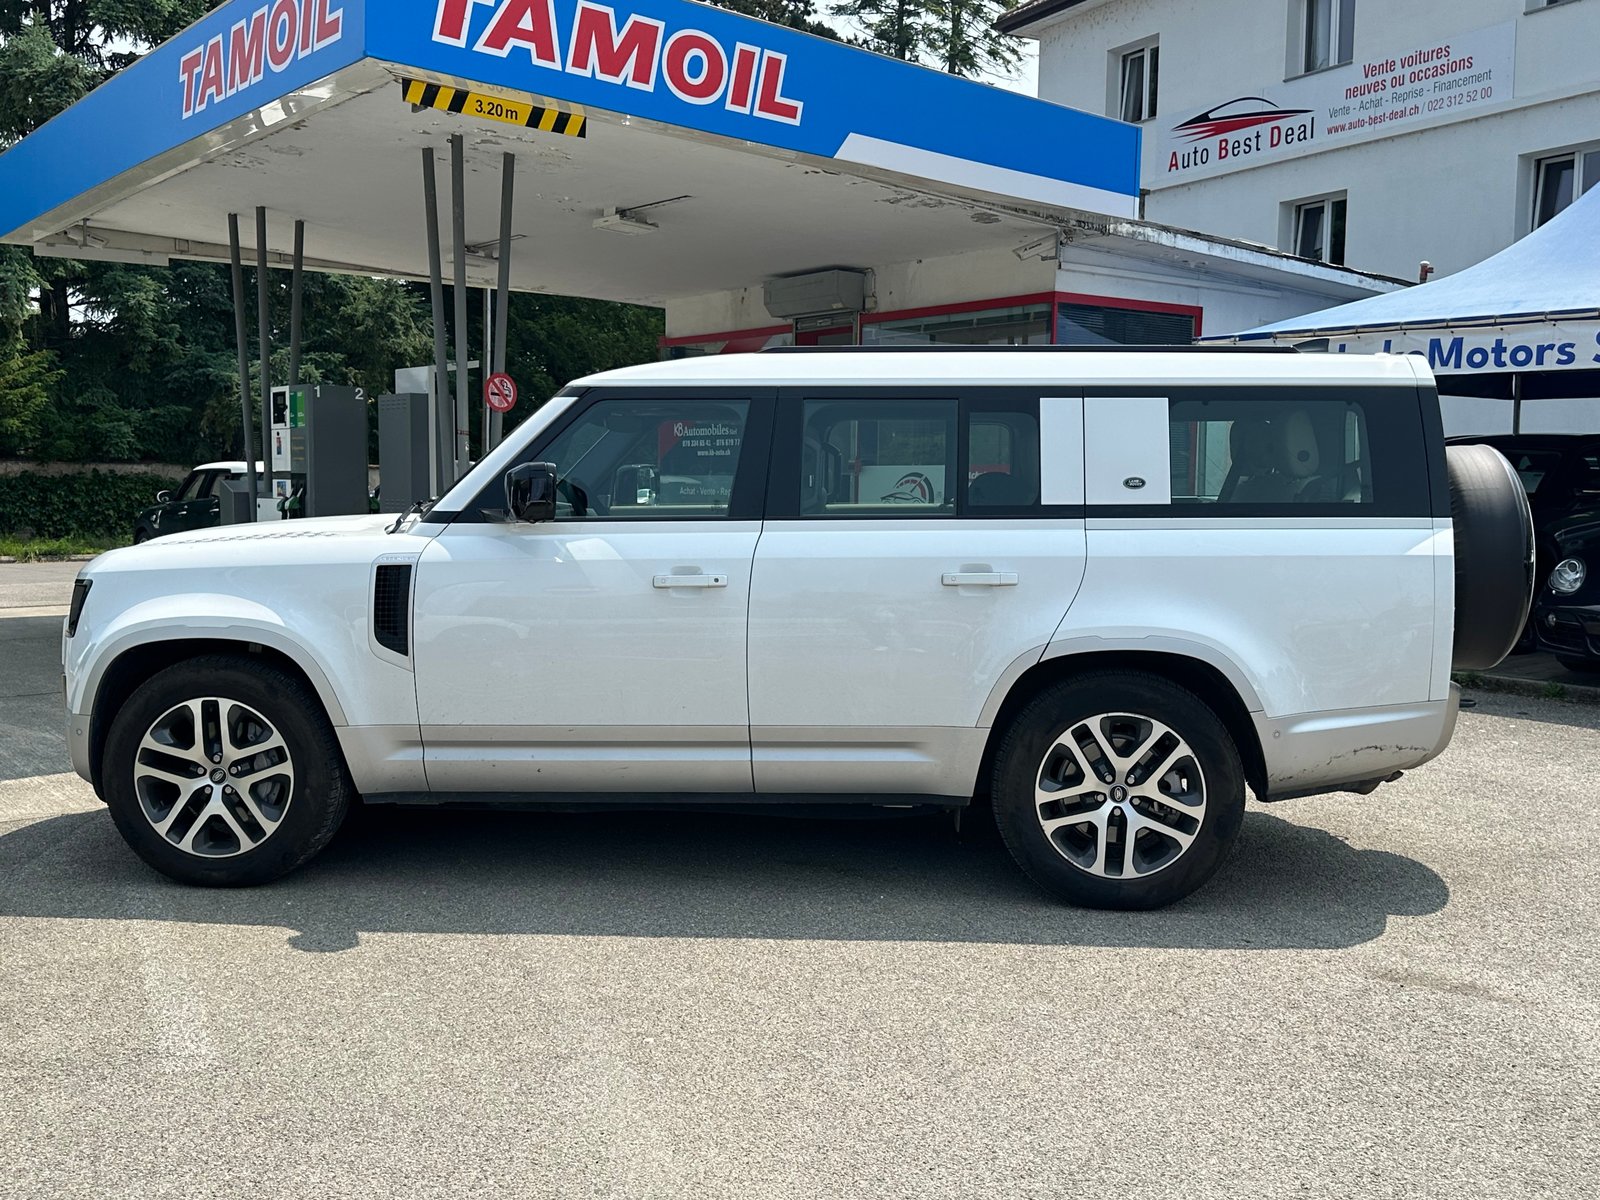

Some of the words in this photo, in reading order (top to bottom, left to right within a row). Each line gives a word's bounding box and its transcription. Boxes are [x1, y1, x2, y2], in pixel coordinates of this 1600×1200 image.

[179, 0, 343, 120] TAMOIL
[432, 0, 803, 126] TAMOIL
[1345, 79, 1386, 100] neuves
[1390, 74, 1405, 88] ou
[1409, 56, 1473, 83] occasions
[1363, 59, 1396, 79] Vente
[1400, 45, 1450, 69] voitures
[475, 99, 503, 117] 3.20
[505, 108, 518, 120] m
[1327, 104, 1419, 135] www.auto-best-deal.ch
[1427, 98, 1444, 112] 022
[1446, 93, 1464, 107] 312
[1466, 89, 1478, 103] 52
[1480, 86, 1493, 100] 00
[1329, 105, 1350, 118] Vente
[1359, 96, 1383, 111] Achat
[1392, 87, 1424, 104] Reprise
[1433, 69, 1492, 93] Financement
[1168, 146, 1209, 172] Auto
[1218, 131, 1261, 160] Best
[1270, 117, 1315, 148] Deal
[314, 385, 320, 398] 1
[355, 387, 364, 400] 2
[683, 423, 729, 436] Automobiles
[680, 486, 696, 495] Achat
[699, 486, 716, 496] Vente
